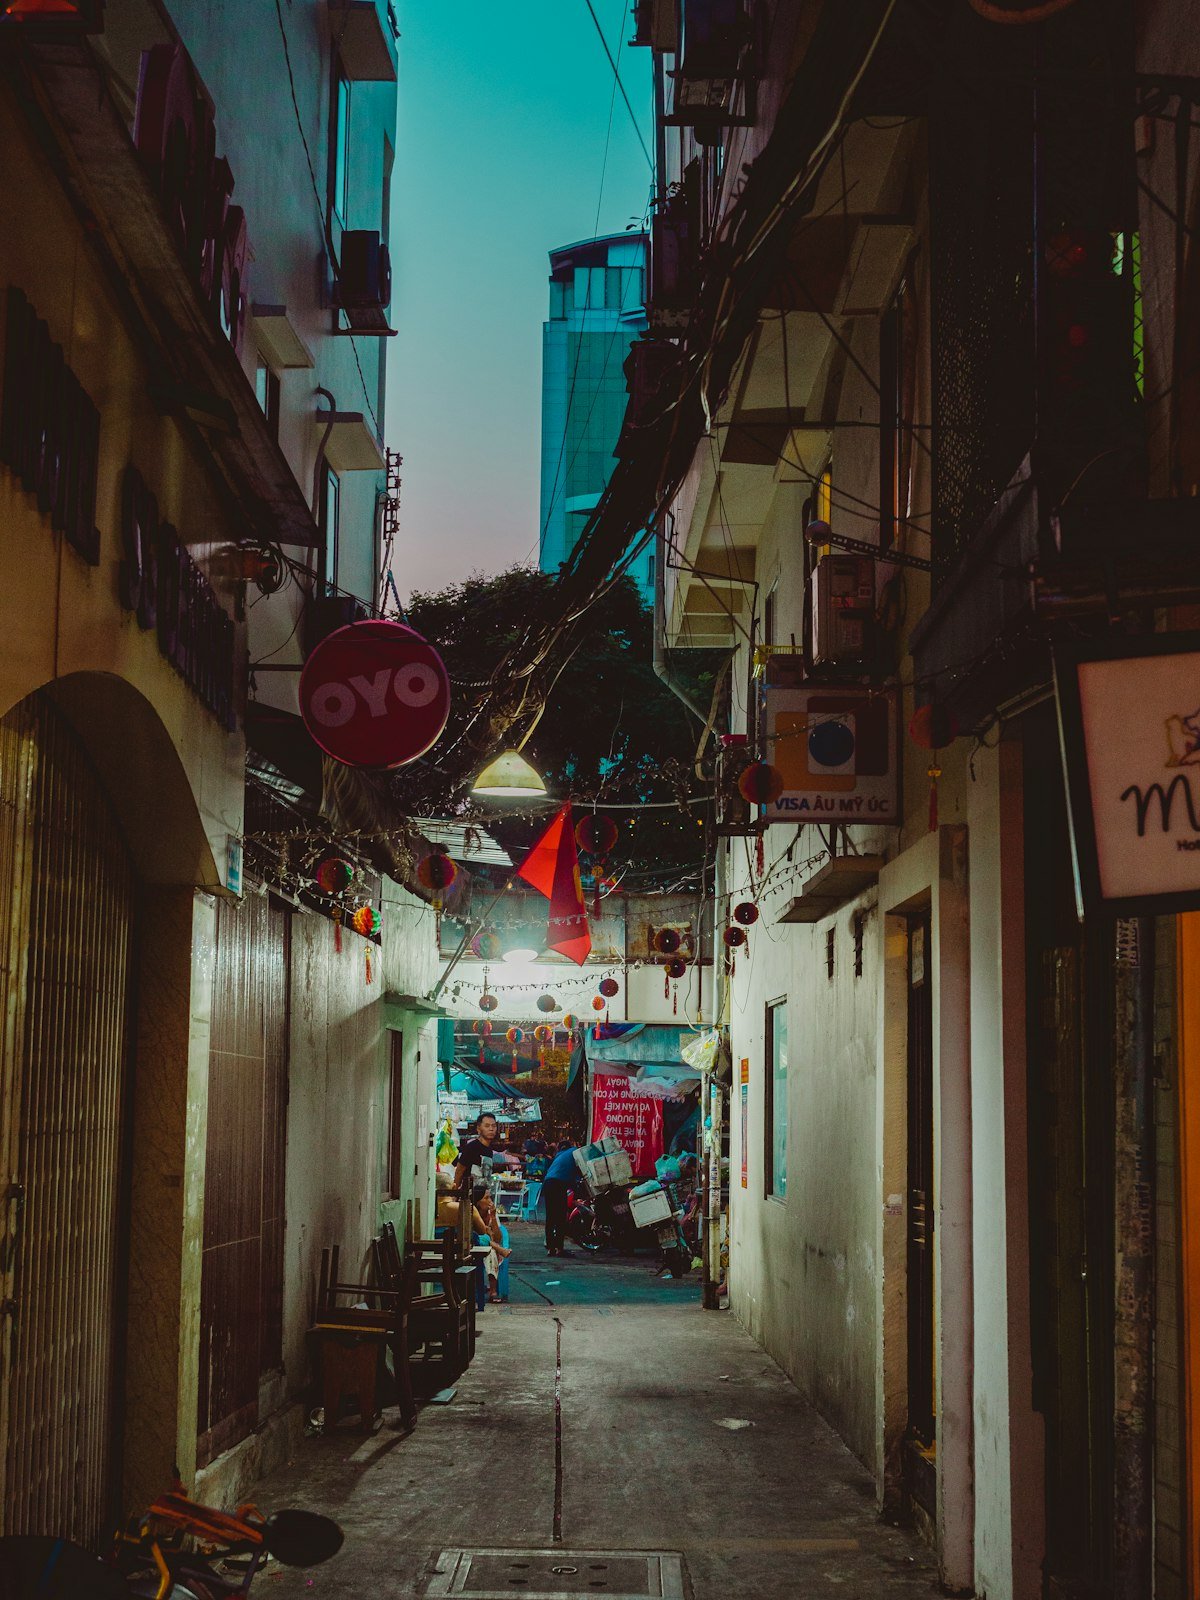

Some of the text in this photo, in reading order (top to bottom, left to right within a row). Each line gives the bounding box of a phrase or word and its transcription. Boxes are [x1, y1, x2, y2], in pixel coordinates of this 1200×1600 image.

[310, 662, 440, 728] OYO
[774, 795, 889, 812] VISA ÂU MỸ ÚC
[606, 1078, 627, 1087] NGÀY
[604, 1101, 621, 1112] KIỆT
[625, 1140, 644, 1148] QUAY
